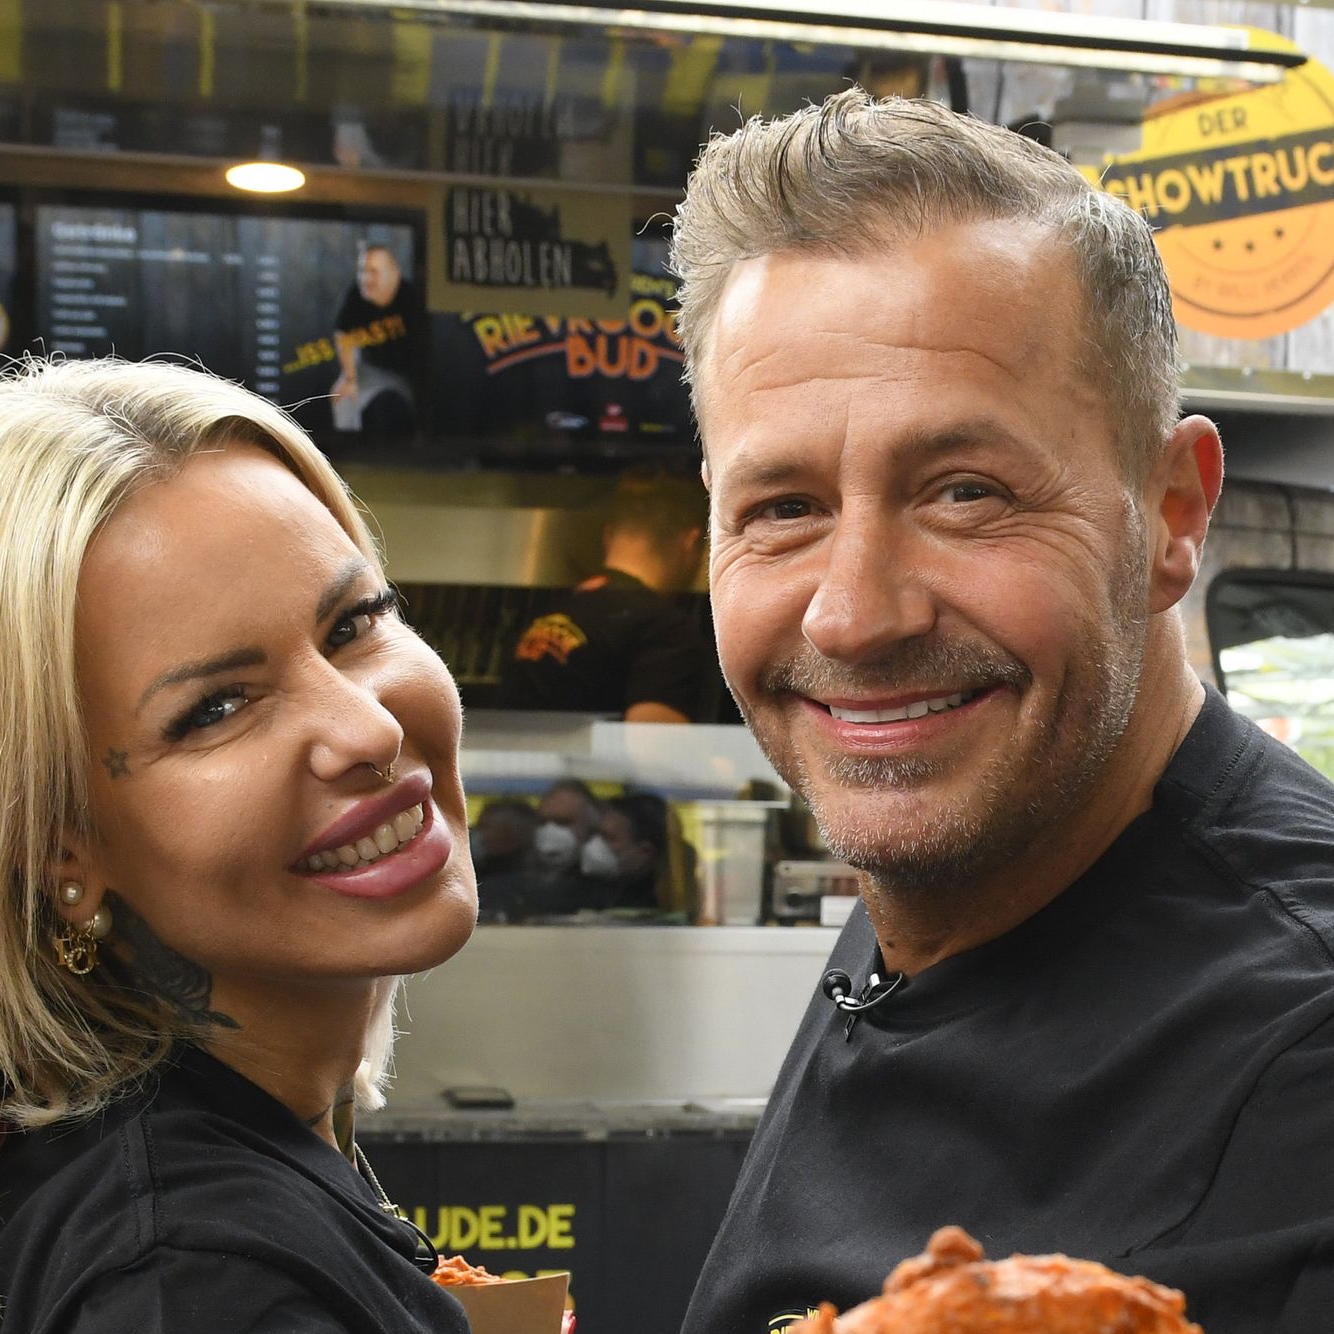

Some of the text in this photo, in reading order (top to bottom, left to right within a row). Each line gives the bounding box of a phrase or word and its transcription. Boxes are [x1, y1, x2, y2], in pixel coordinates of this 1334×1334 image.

[1197, 105, 1248, 138] DER
[452, 190, 513, 237] HIER
[452, 237, 573, 288] ABHOLEN
[566, 334, 659, 380] BUD
